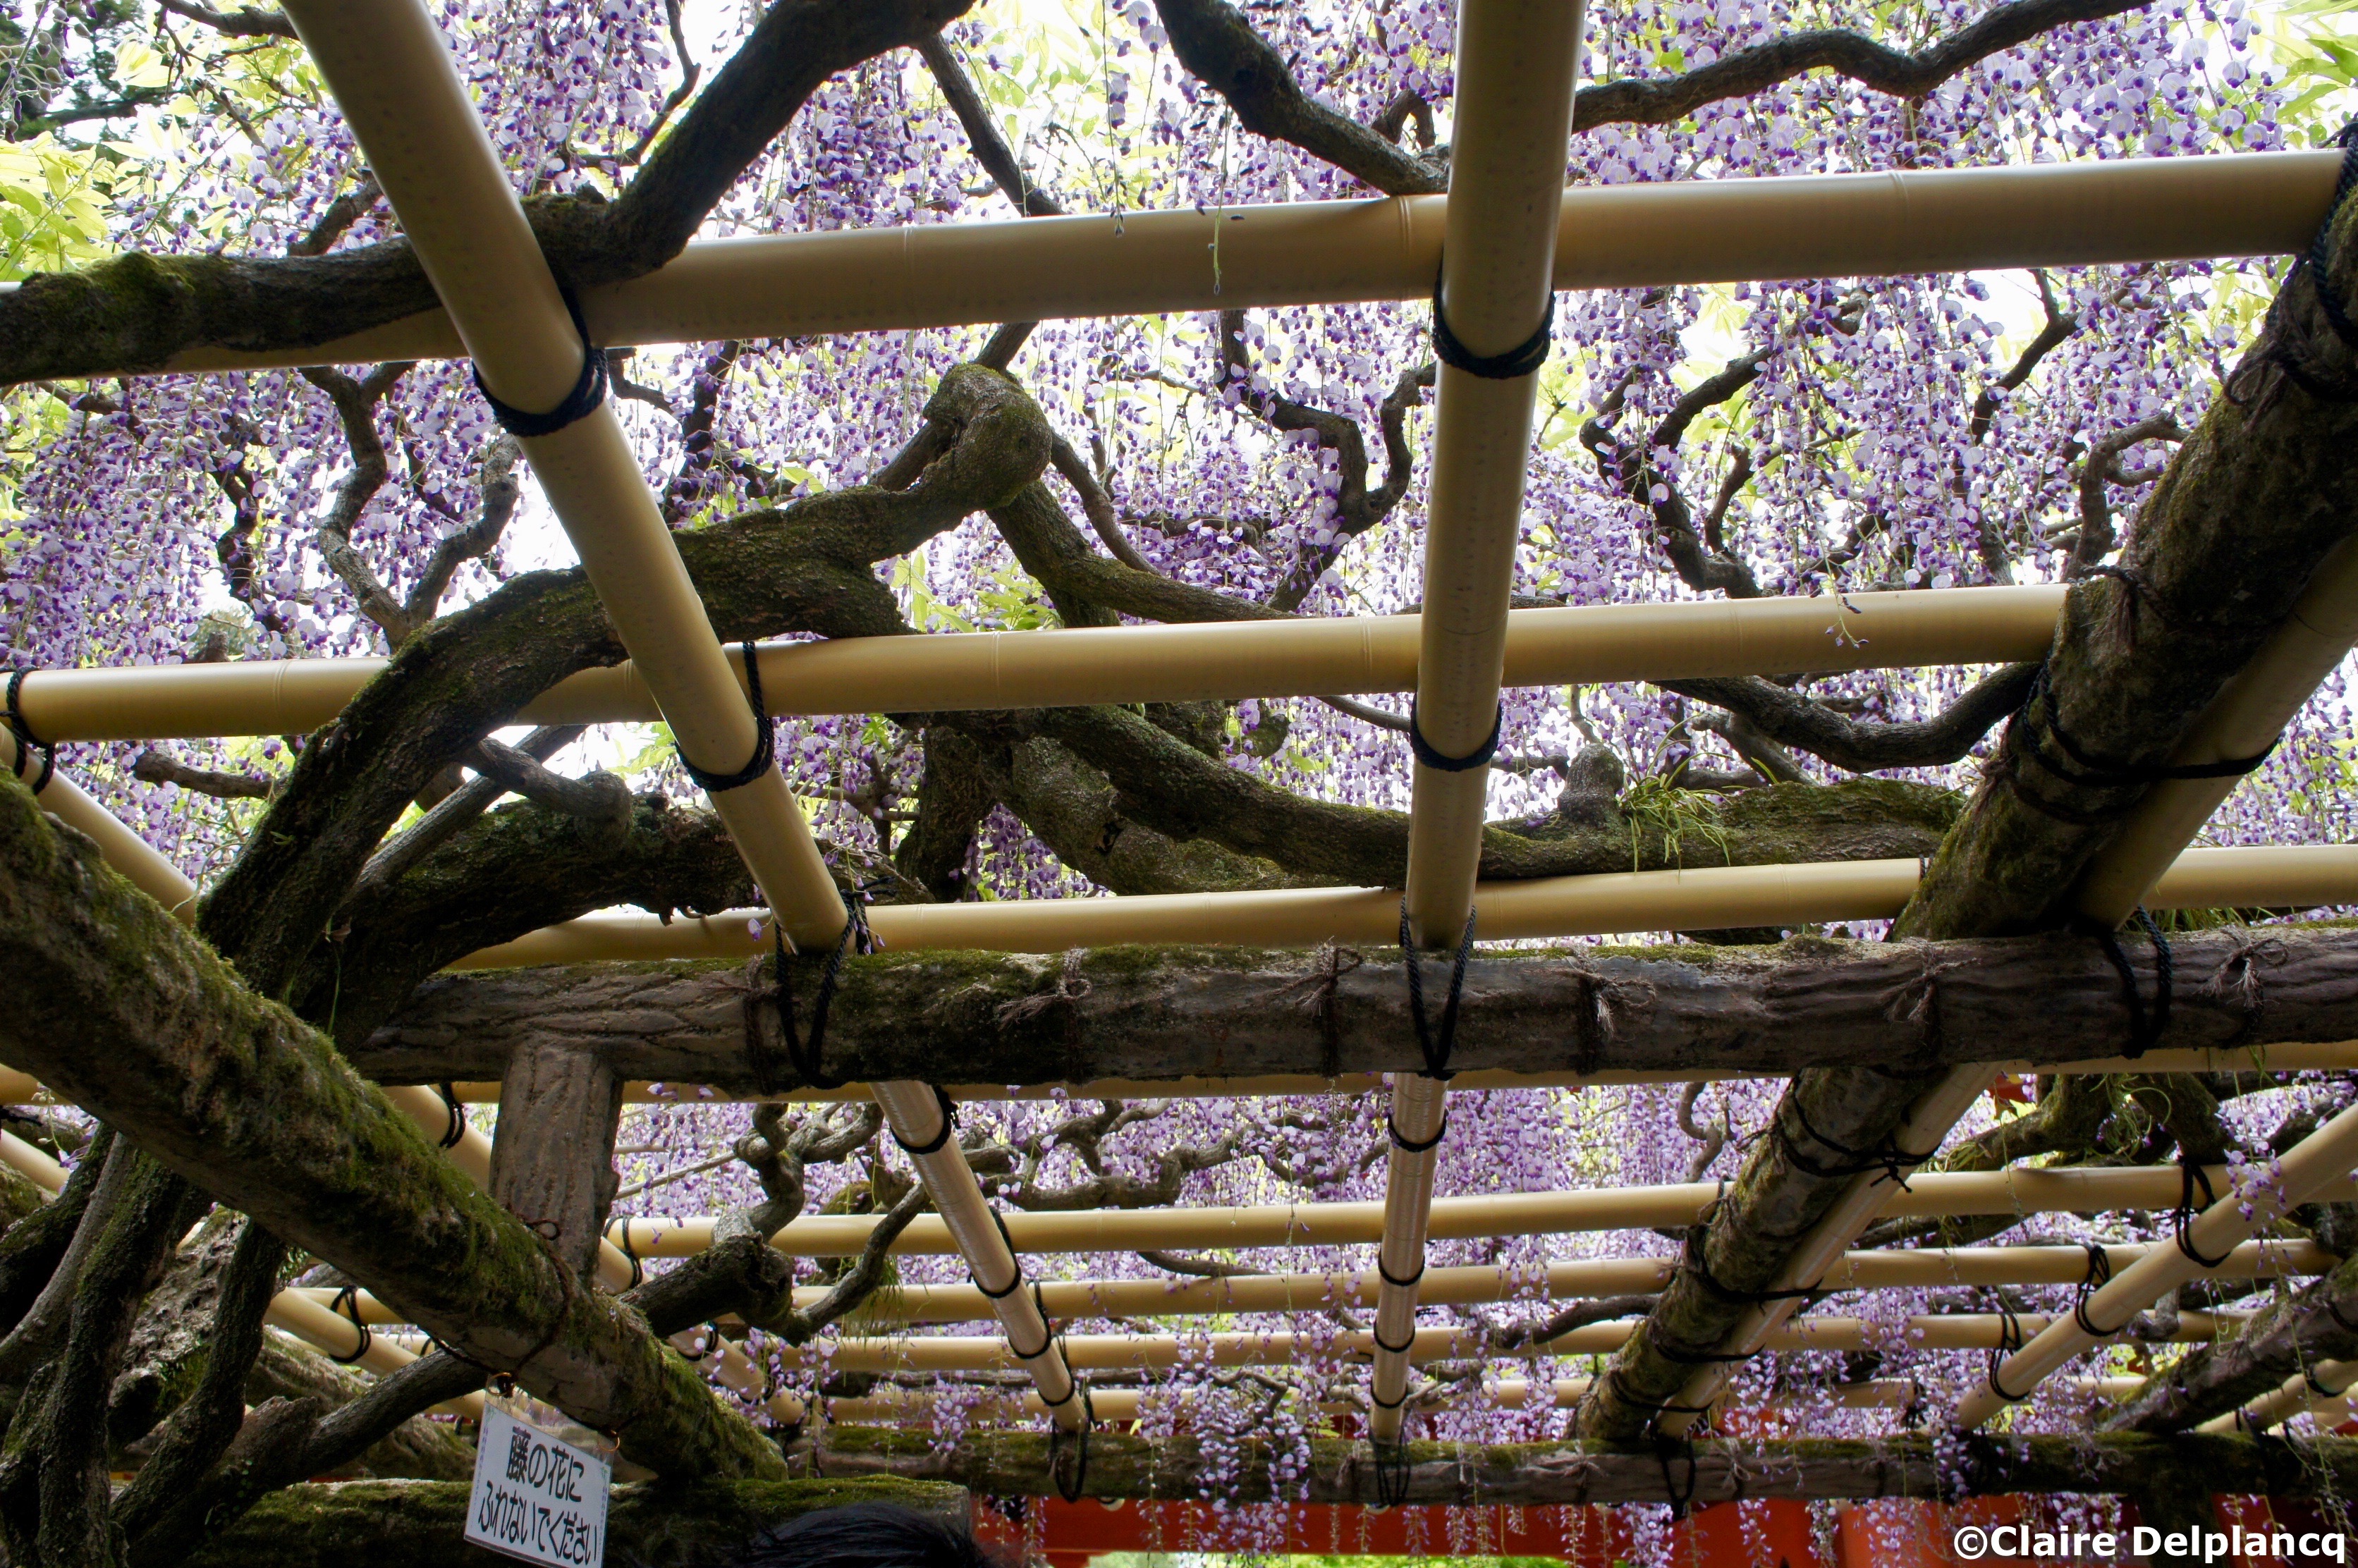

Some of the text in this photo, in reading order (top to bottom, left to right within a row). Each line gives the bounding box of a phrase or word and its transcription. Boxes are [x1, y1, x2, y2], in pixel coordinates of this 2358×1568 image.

[506, 1426, 585, 1502] 藤の花に
[478, 1480, 597, 1565] ふれないでください
